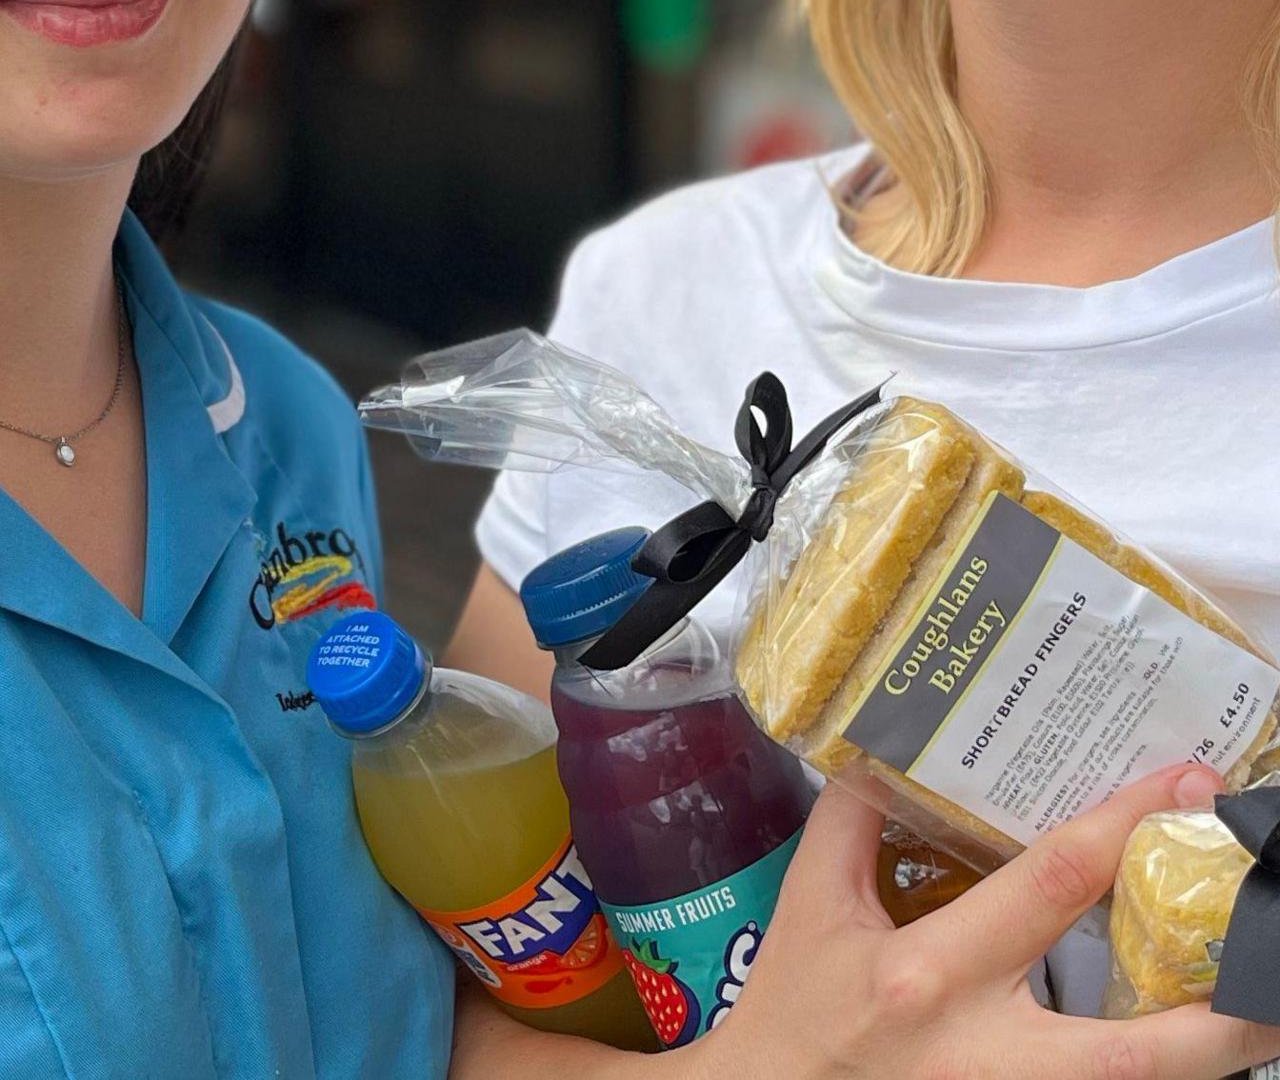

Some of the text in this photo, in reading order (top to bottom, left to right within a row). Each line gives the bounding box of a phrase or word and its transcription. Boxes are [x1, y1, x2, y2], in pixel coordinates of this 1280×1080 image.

[326, 634, 379, 644] ATTACHED
[884, 554, 989, 697] Coughlans
[927, 600, 1008, 696] Bakery
[317, 657, 369, 667] TOGETHER
[331, 645, 379, 656] RECYCLE
[960, 591, 1087, 770] SHORTBREAD FINGERS
[1219, 682, 1250, 729] £4.50
[1220, 696, 1261, 753] environment
[1034, 784, 1068, 831] ALLERGIES?
[616, 885, 737, 934] SUMMER FRUITS
